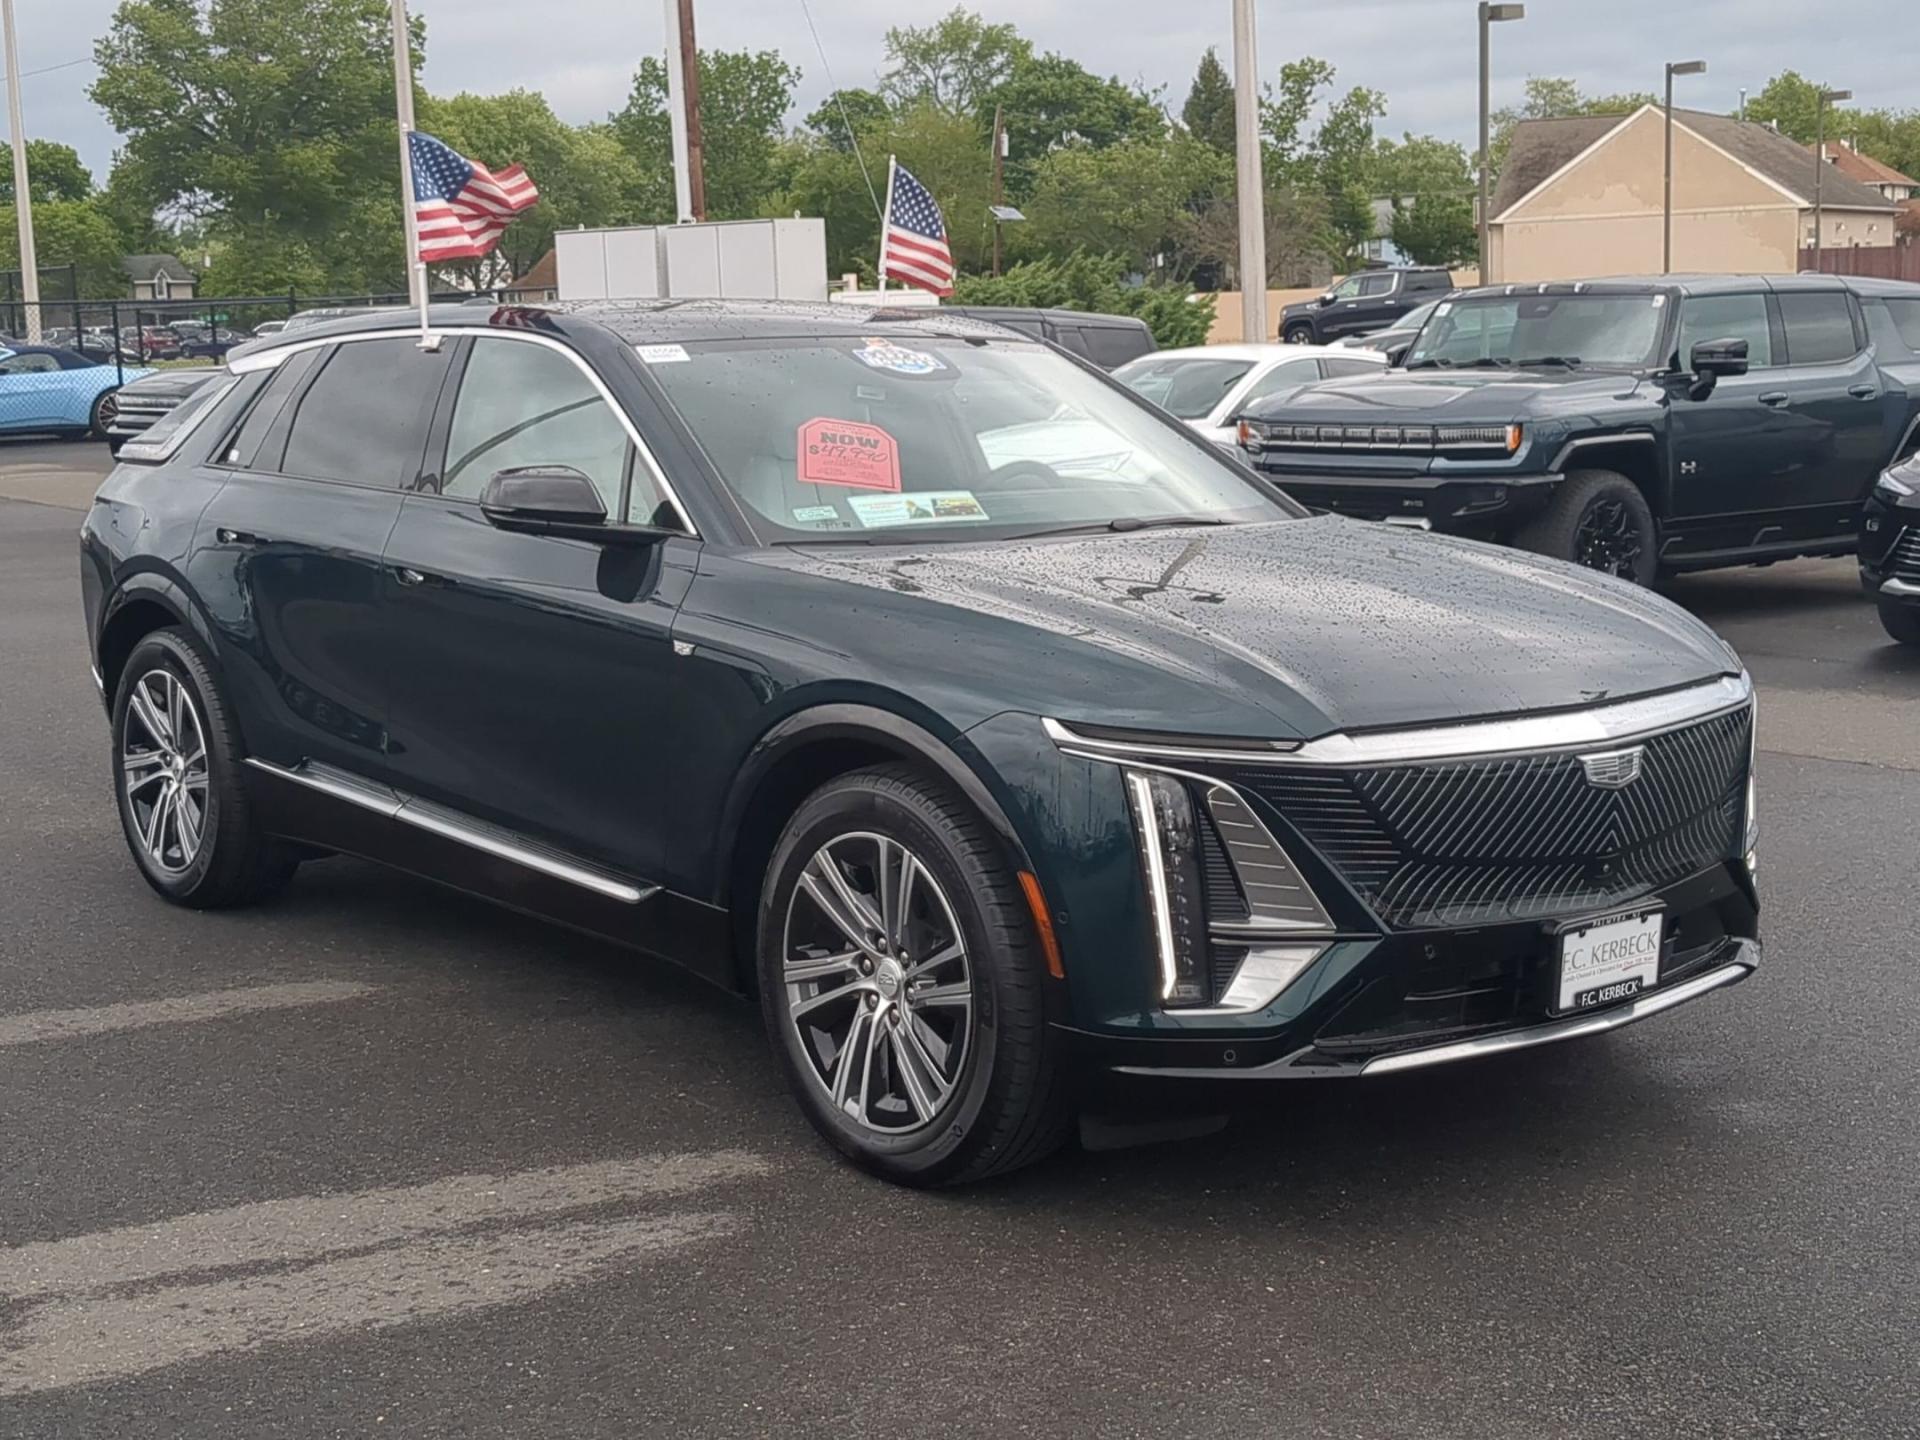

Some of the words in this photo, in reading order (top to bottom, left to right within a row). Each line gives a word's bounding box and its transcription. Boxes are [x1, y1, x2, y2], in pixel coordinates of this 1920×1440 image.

[820, 432, 880, 449] NOW
[1591, 930, 1658, 965] KERBECK
[1581, 991, 1597, 1007] F.C.
[1598, 980, 1639, 1002] KERBECK
